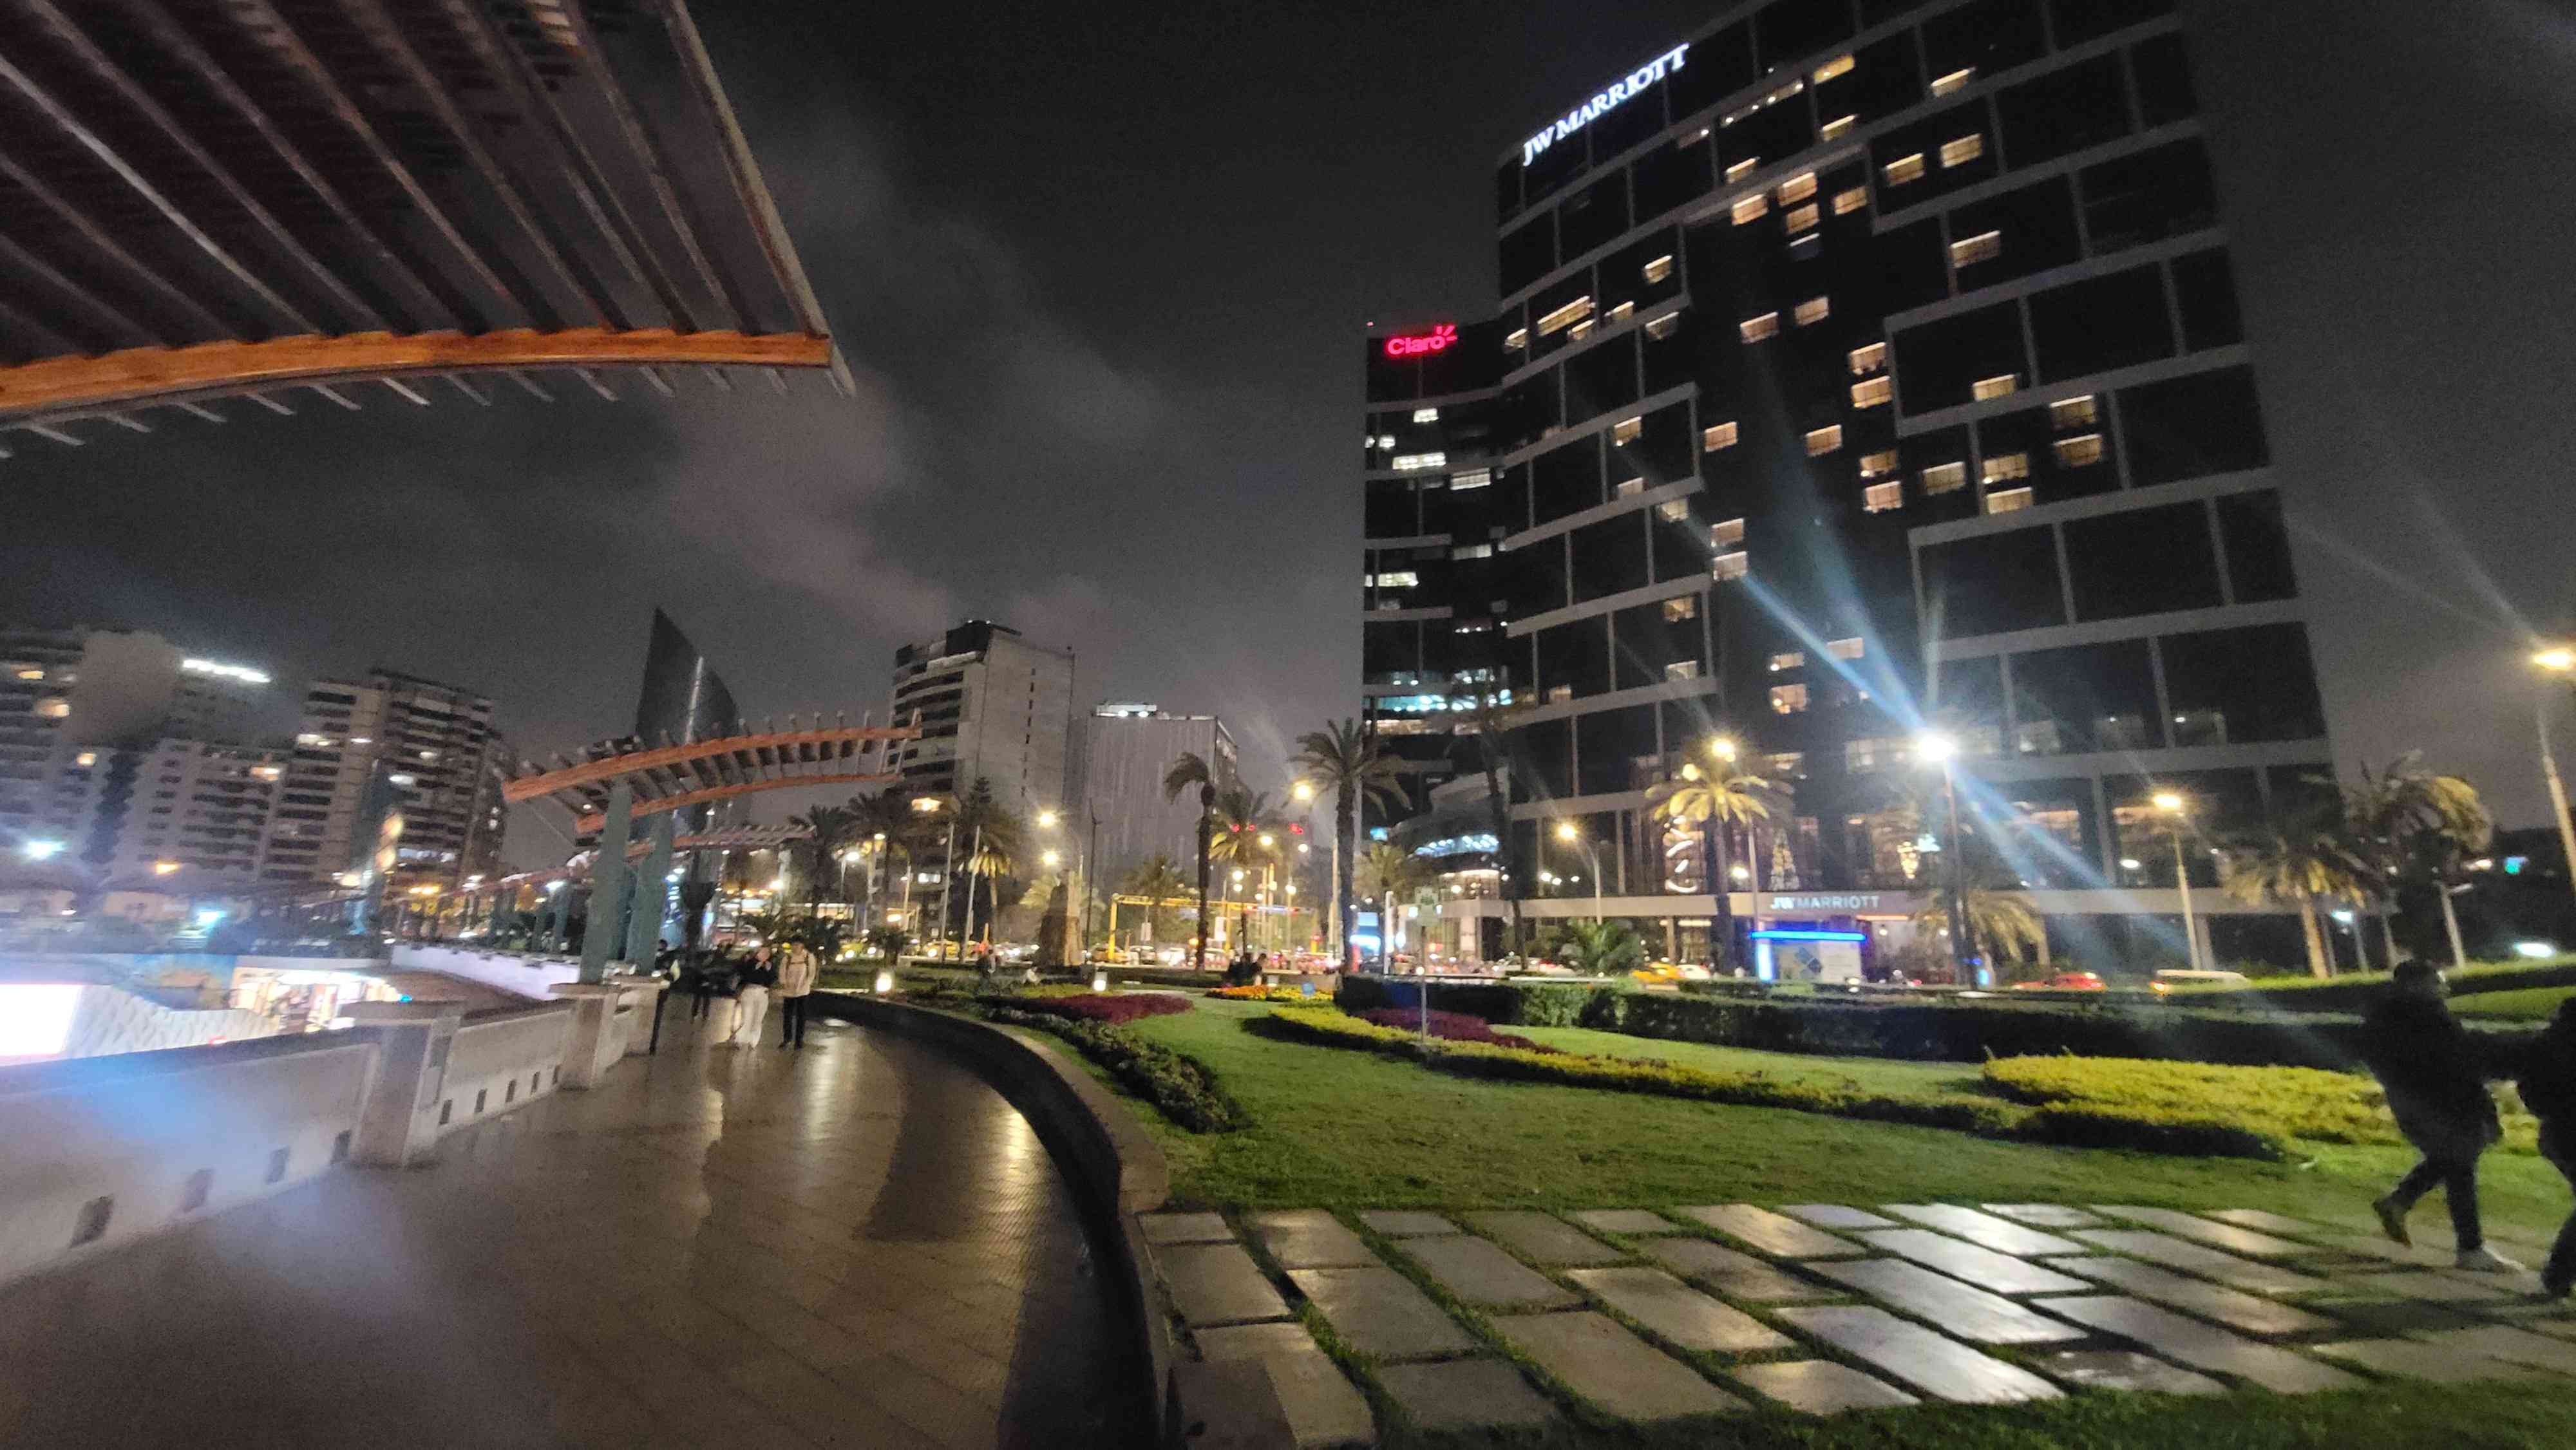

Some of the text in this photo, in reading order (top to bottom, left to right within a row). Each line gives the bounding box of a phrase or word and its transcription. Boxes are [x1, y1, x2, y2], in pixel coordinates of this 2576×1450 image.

[1522, 42, 1690, 167] JW MARRIOTT
[1387, 335, 1446, 355] Claro
[1795, 896, 1880, 909] MARRIOTT
